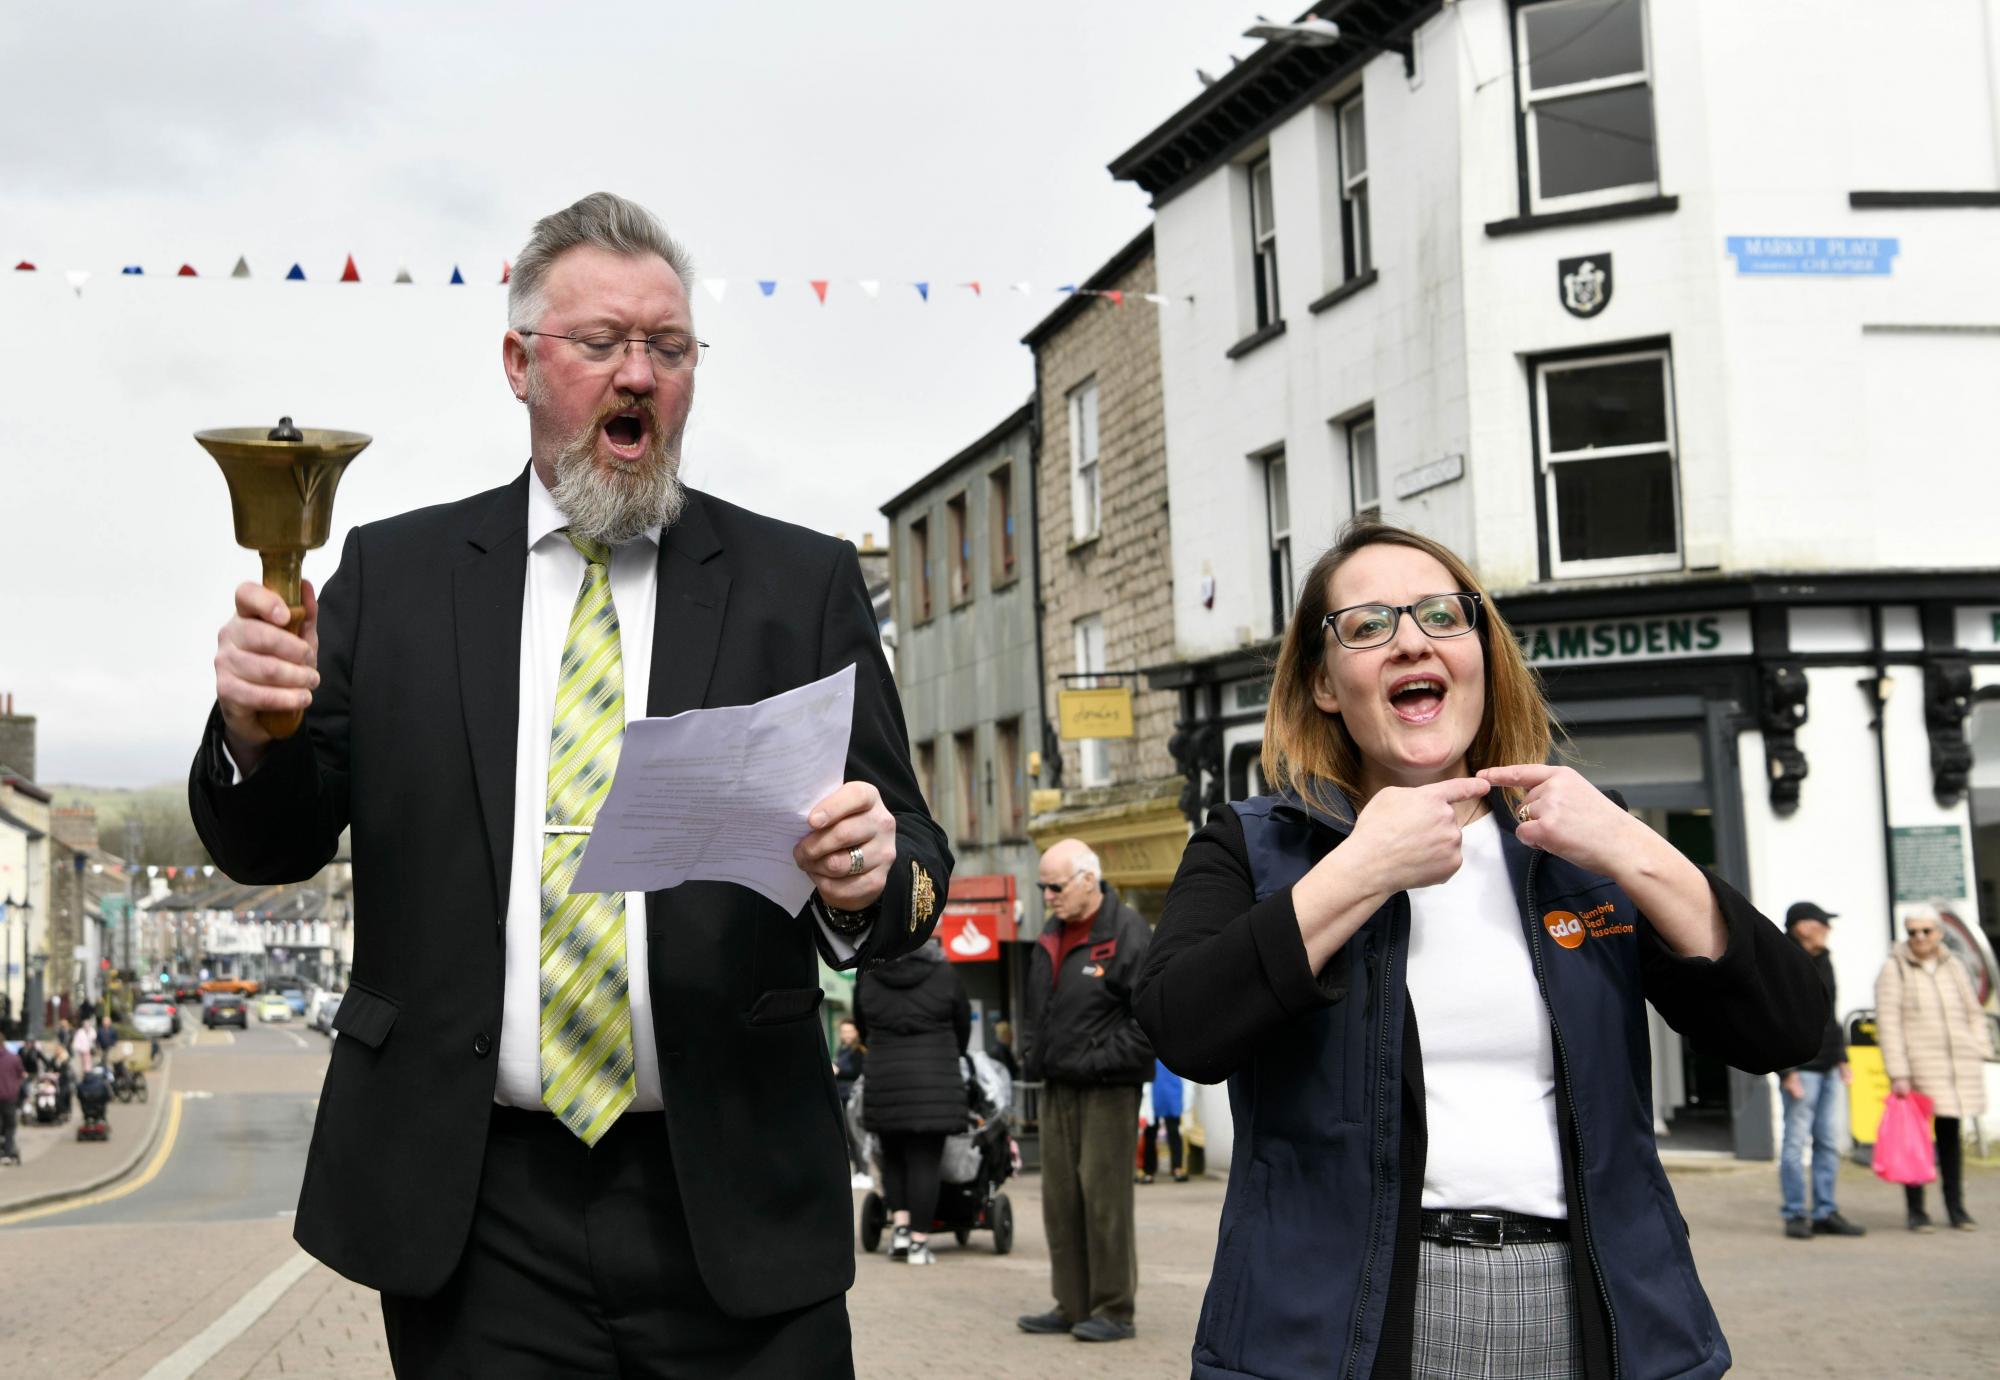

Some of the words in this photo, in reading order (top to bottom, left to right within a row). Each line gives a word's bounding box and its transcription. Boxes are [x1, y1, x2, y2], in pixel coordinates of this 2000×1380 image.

[1744, 239, 1815, 256] MARKET
[1827, 239, 1878, 257] PLACE
[1579, 901, 1614, 919] Cumbria
[1549, 918, 1581, 937] cda
[1584, 917, 1606, 928] Deaf
[1591, 923, 1633, 937] Association
